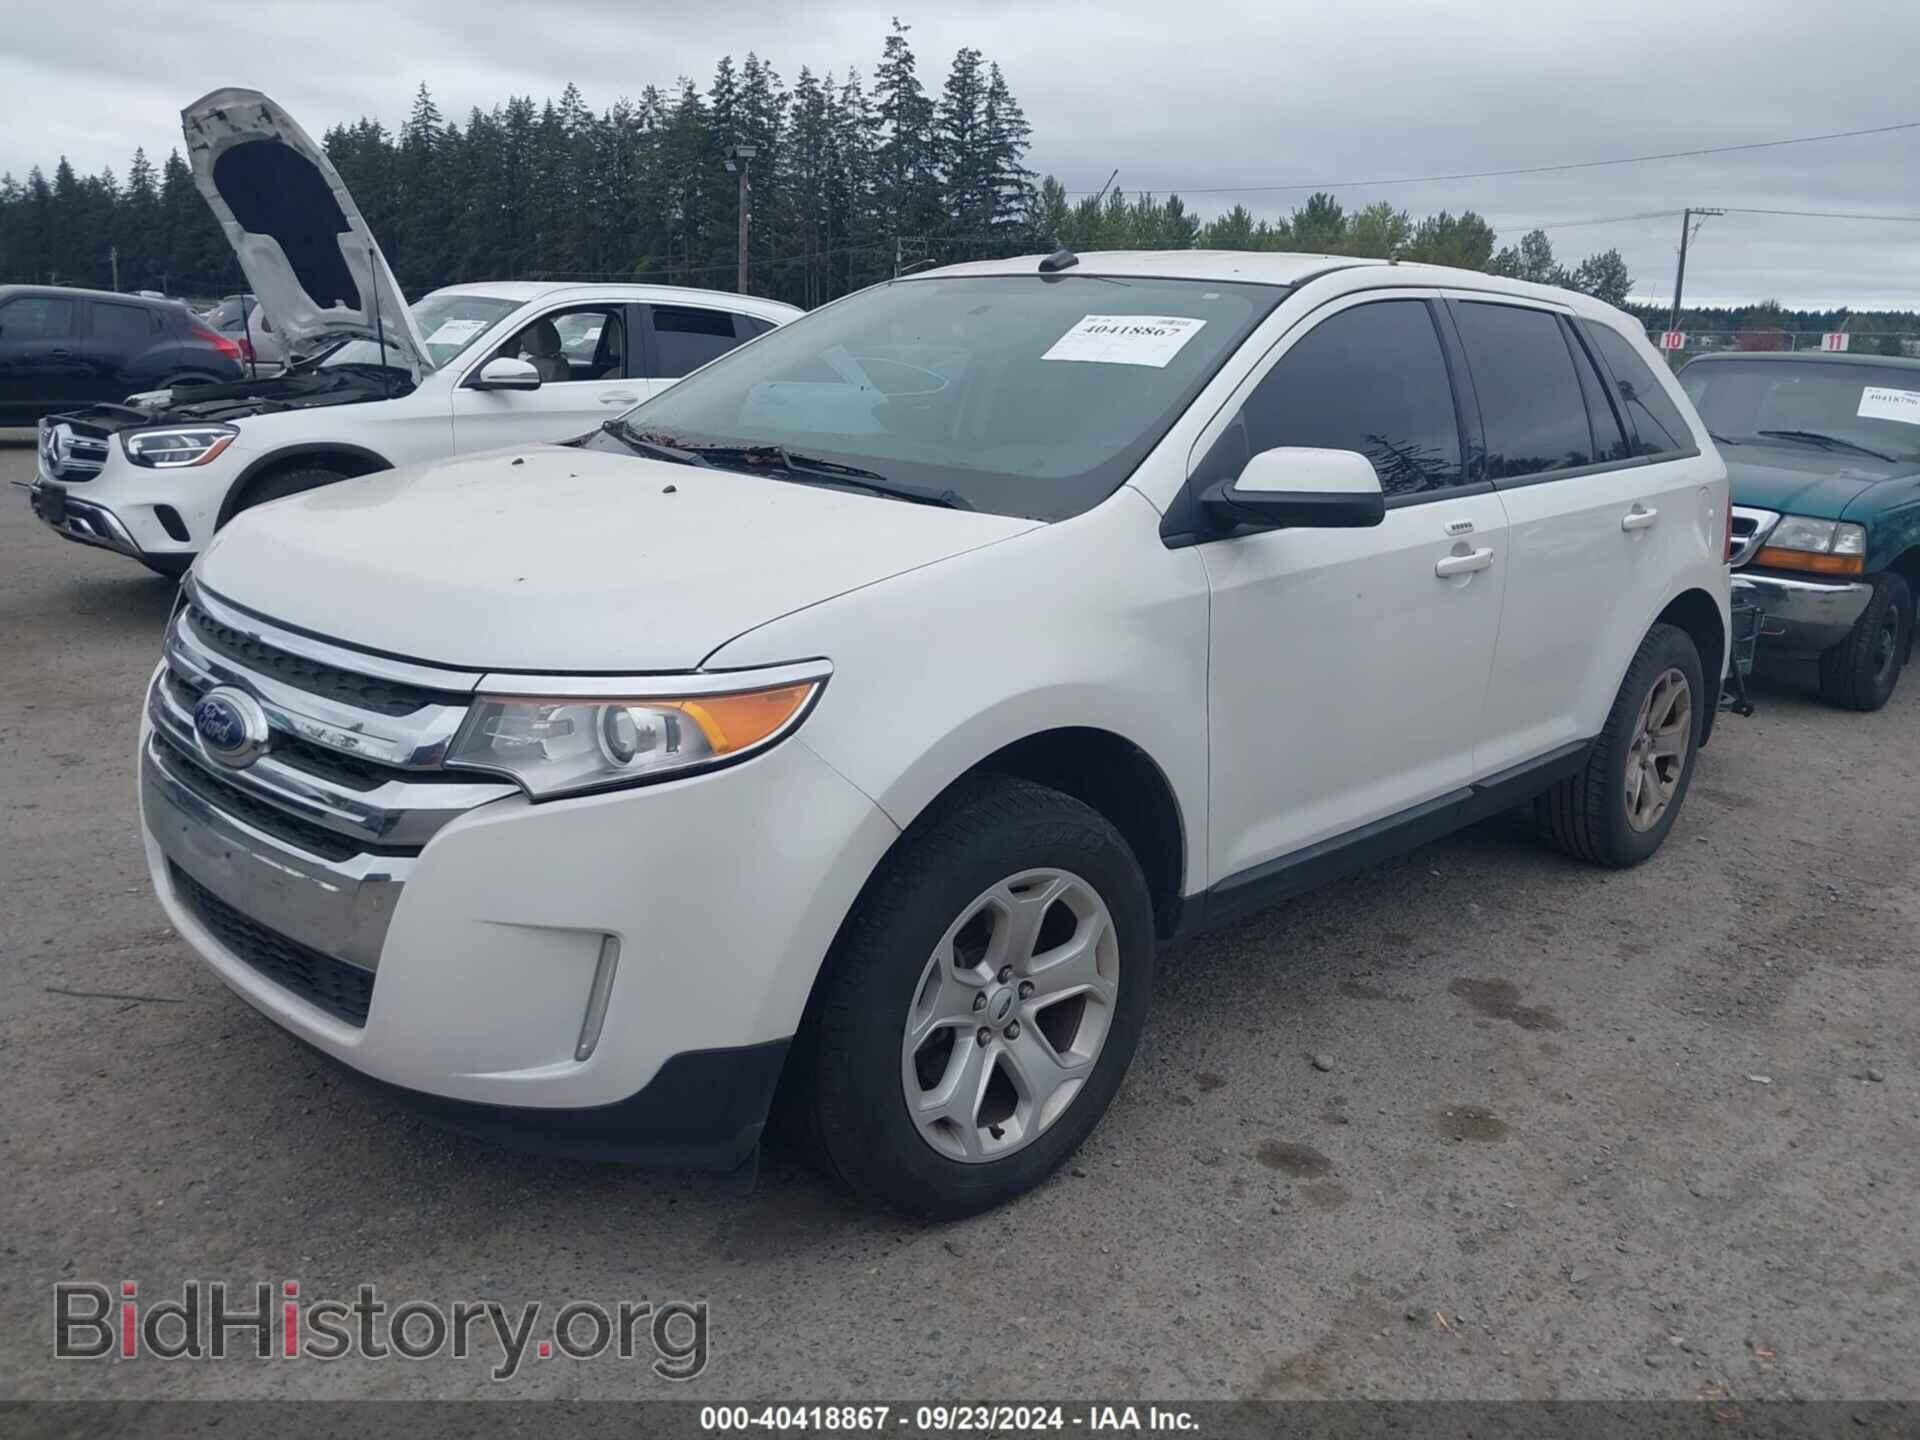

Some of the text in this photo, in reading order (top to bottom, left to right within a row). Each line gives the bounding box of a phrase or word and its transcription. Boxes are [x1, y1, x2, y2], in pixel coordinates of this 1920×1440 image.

[1082, 324, 1181, 337] 40418867
[1664, 333, 1682, 350] 10
[1828, 334, 1842, 350] 11
[200, 702, 233, 742] Ford
